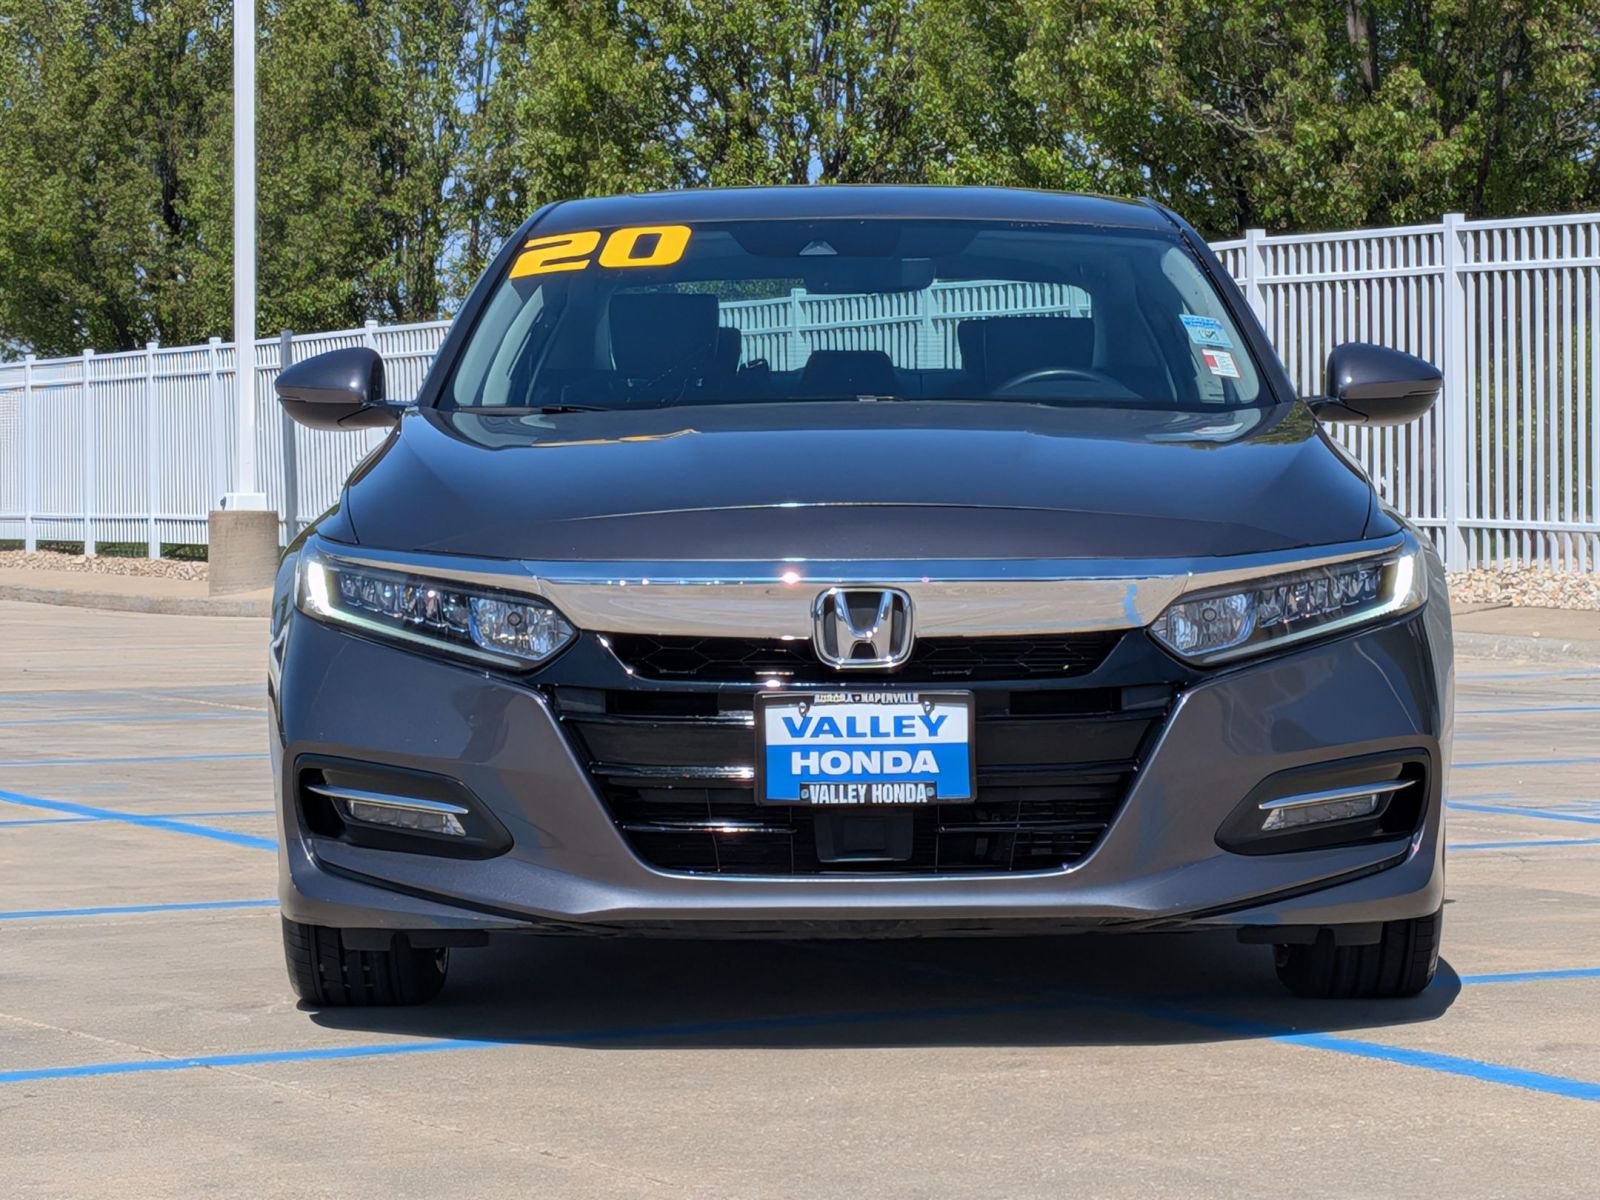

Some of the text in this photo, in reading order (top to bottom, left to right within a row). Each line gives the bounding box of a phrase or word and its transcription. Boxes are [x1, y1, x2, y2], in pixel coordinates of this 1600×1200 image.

[508, 225, 693, 279] 20
[782, 715, 949, 738] VALLEY
[791, 750, 940, 775] HONDA
[809, 783, 928, 804] VALLEY HONDA
